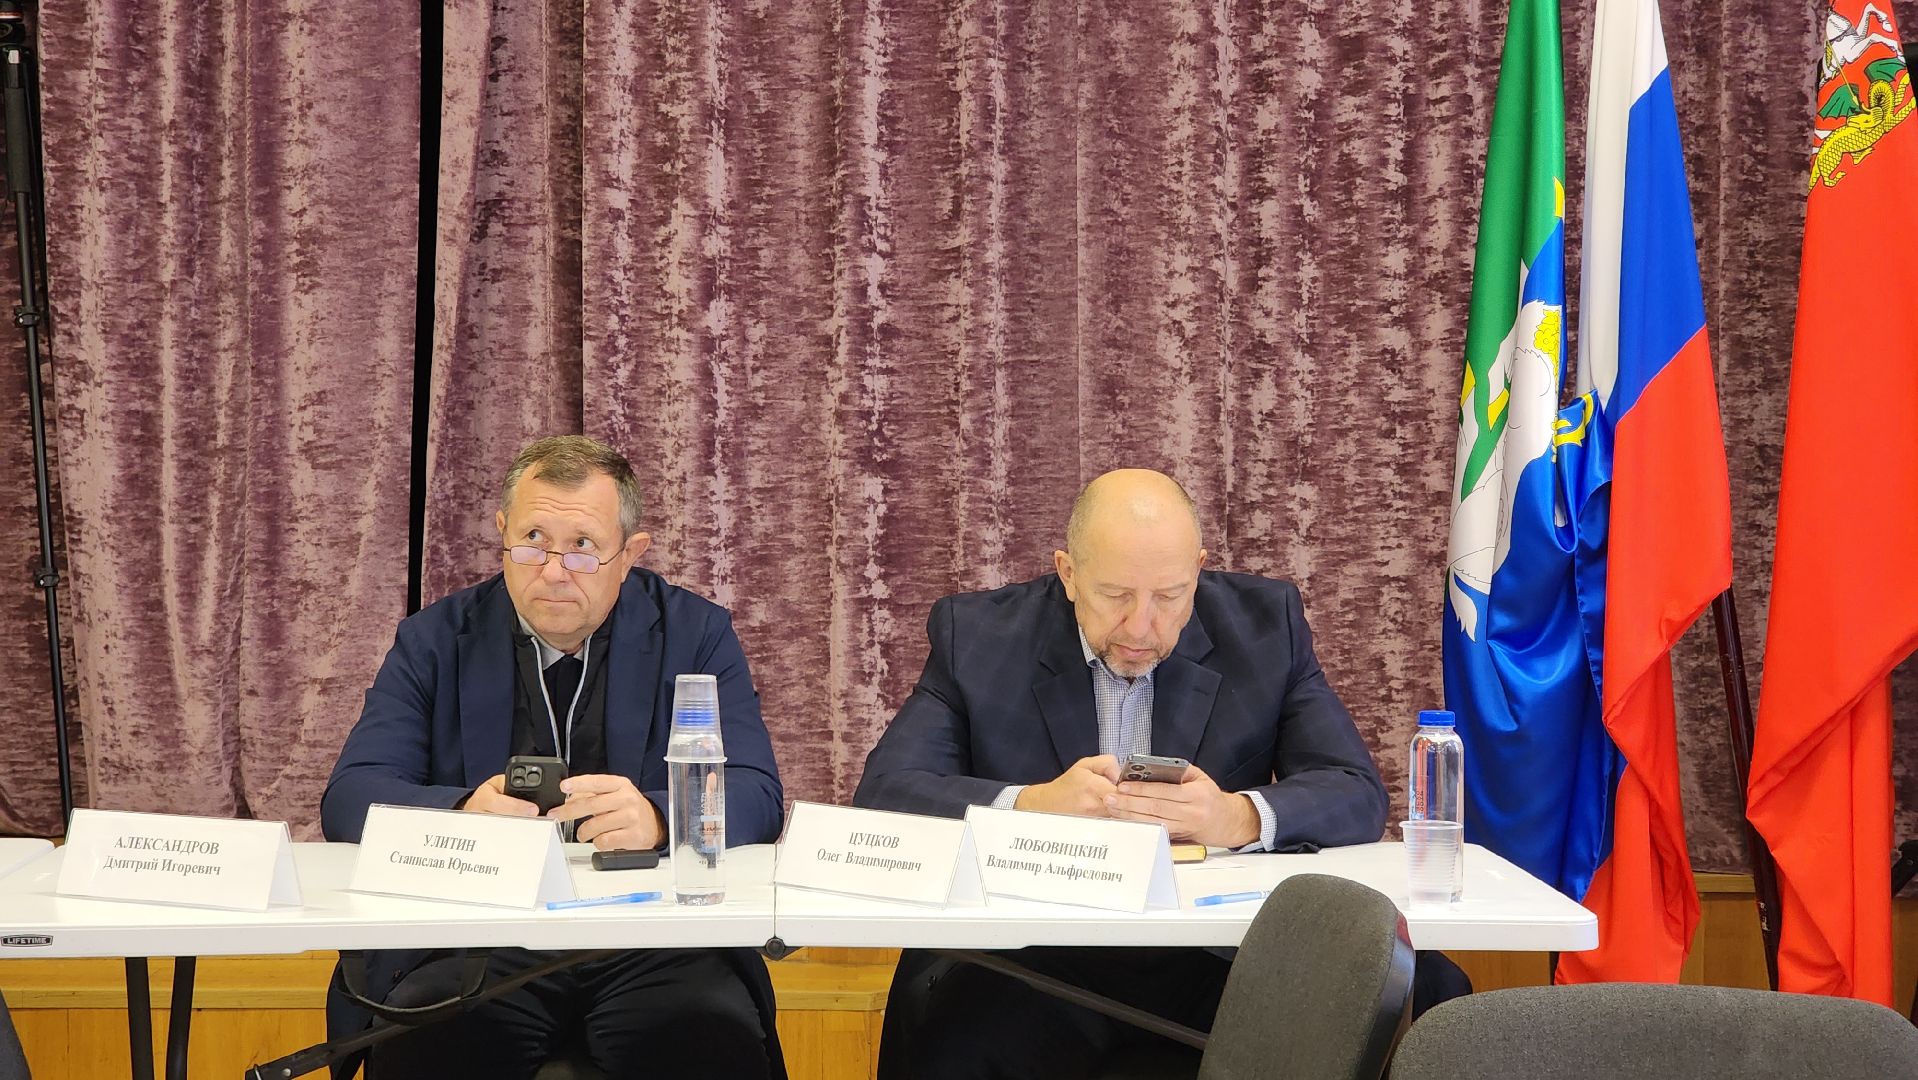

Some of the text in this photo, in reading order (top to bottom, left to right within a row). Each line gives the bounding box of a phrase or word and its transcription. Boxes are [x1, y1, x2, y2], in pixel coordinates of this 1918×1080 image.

[114, 836, 220, 855] АЛЕКСАНДРОВ
[423, 834, 477, 852] УЛИТИН
[848, 832, 900, 849] ЦУЦКОВ
[1009, 837, 1109, 860] ЛЮБОВИЦКИЙ
[103, 856, 221, 876] Дмитрий Игоревич
[390, 850, 500, 876] Станислав Юрьевич
[816, 848, 922, 871] Олег Владимирович
[986, 854, 1123, 882] Владимир Альфредович
